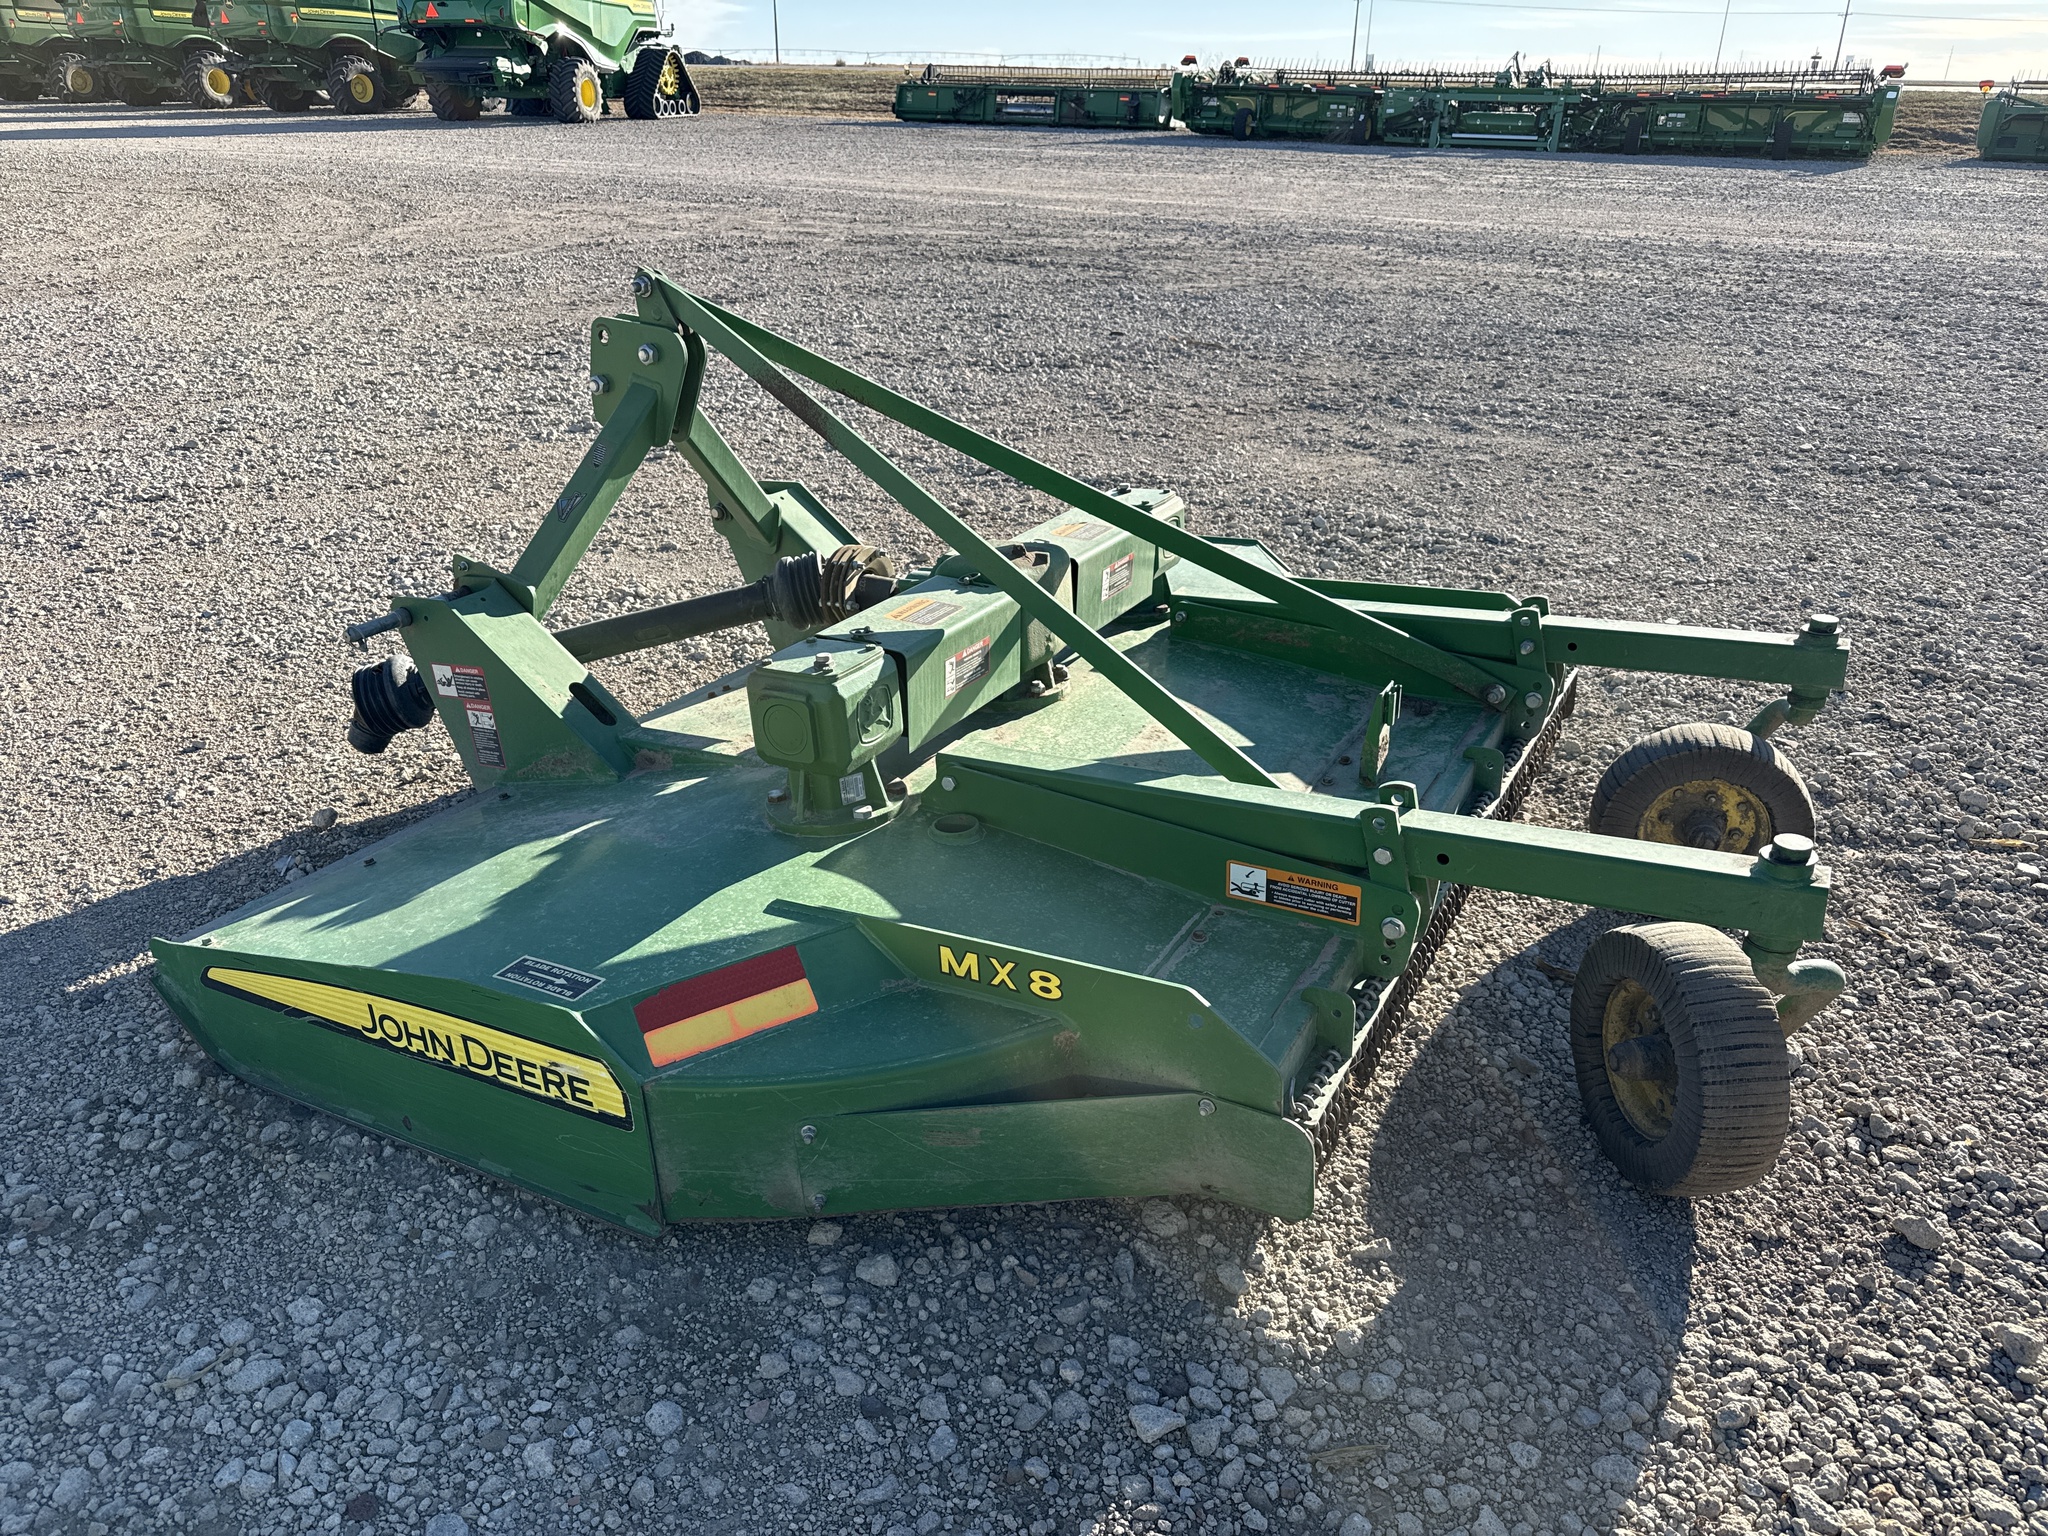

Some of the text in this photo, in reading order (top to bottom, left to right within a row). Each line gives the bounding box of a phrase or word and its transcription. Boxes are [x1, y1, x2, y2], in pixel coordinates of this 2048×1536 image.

[1297, 876, 1339, 891] WARNING
[524, 960, 593, 984] BLADE ROTATION
[505, 972, 574, 997] BLADE ROTATION
[361, 1003, 595, 1107] JOHN DEERE
